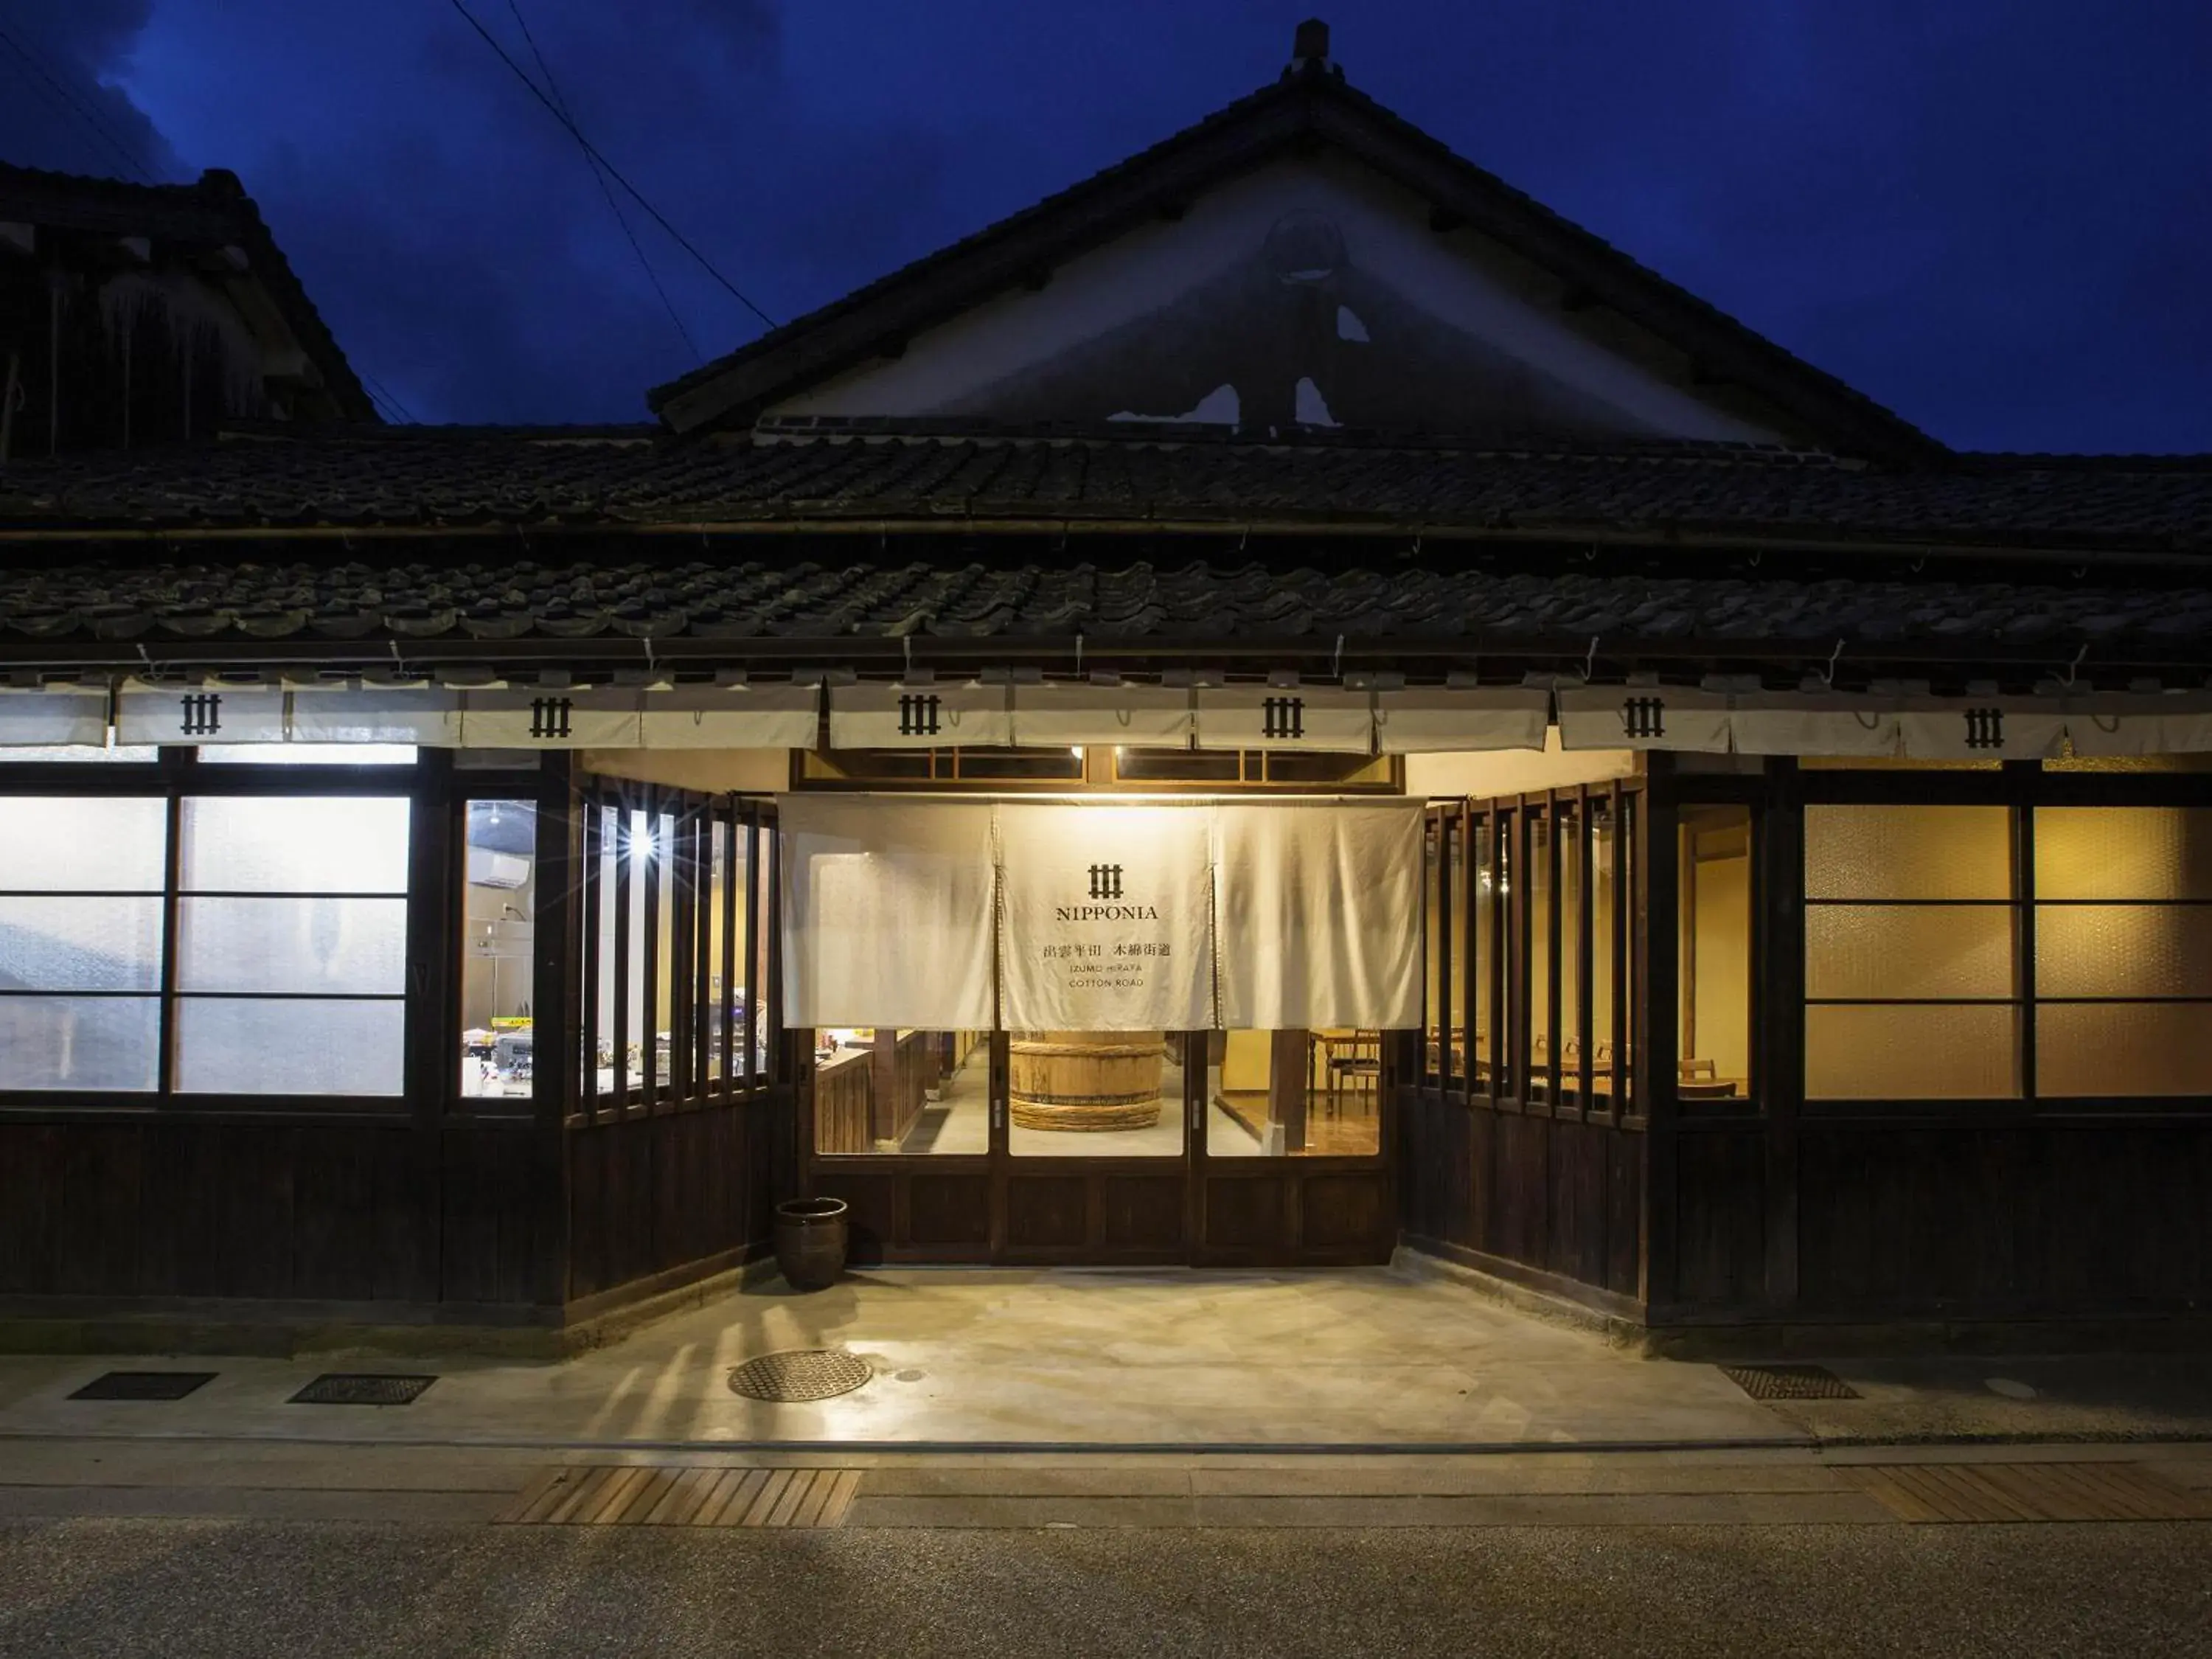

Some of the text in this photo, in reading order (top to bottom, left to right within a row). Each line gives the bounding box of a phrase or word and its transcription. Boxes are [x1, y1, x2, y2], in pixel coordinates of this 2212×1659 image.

[1056, 906, 1159, 921] NIPPONIA
[1043, 943, 1171, 958] 出雲平田 木綿街道
[1069, 964, 1143, 973] IZUMO HIRATA
[1068, 978, 1144, 988] COTTON ROAD
